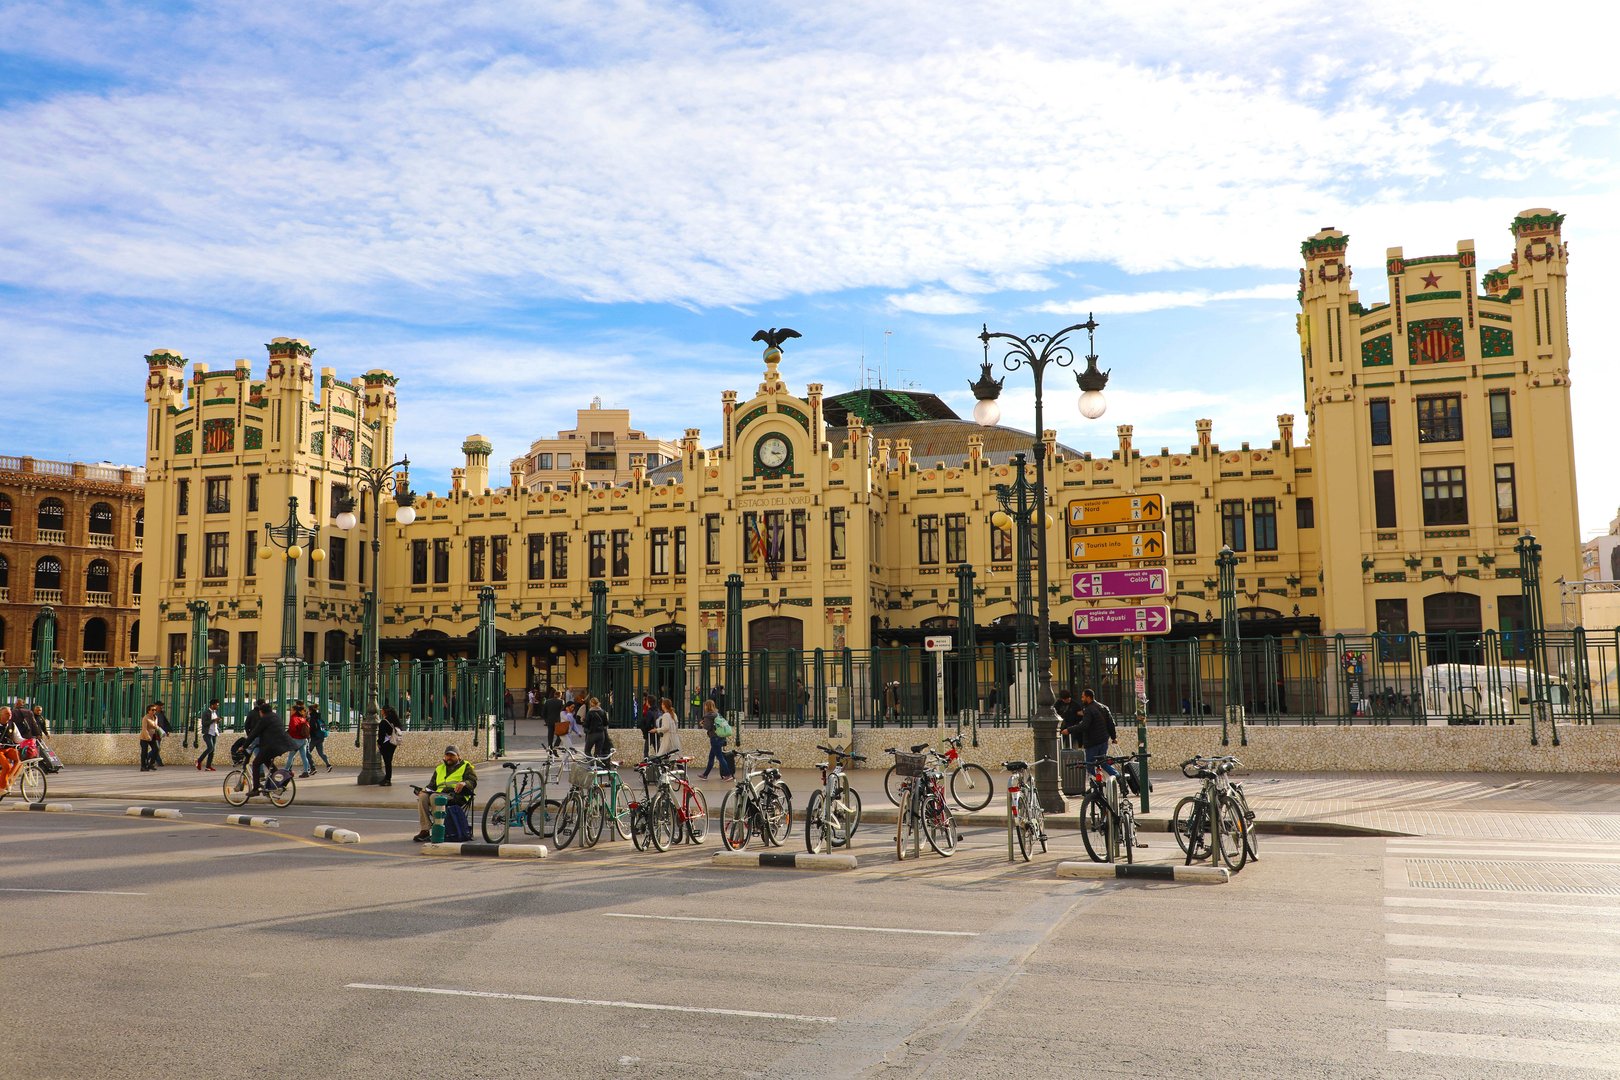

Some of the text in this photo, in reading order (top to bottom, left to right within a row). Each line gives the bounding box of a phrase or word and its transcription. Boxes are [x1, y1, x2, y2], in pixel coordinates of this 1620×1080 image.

[739, 496, 810, 508] ESTACIO DEL NORD
